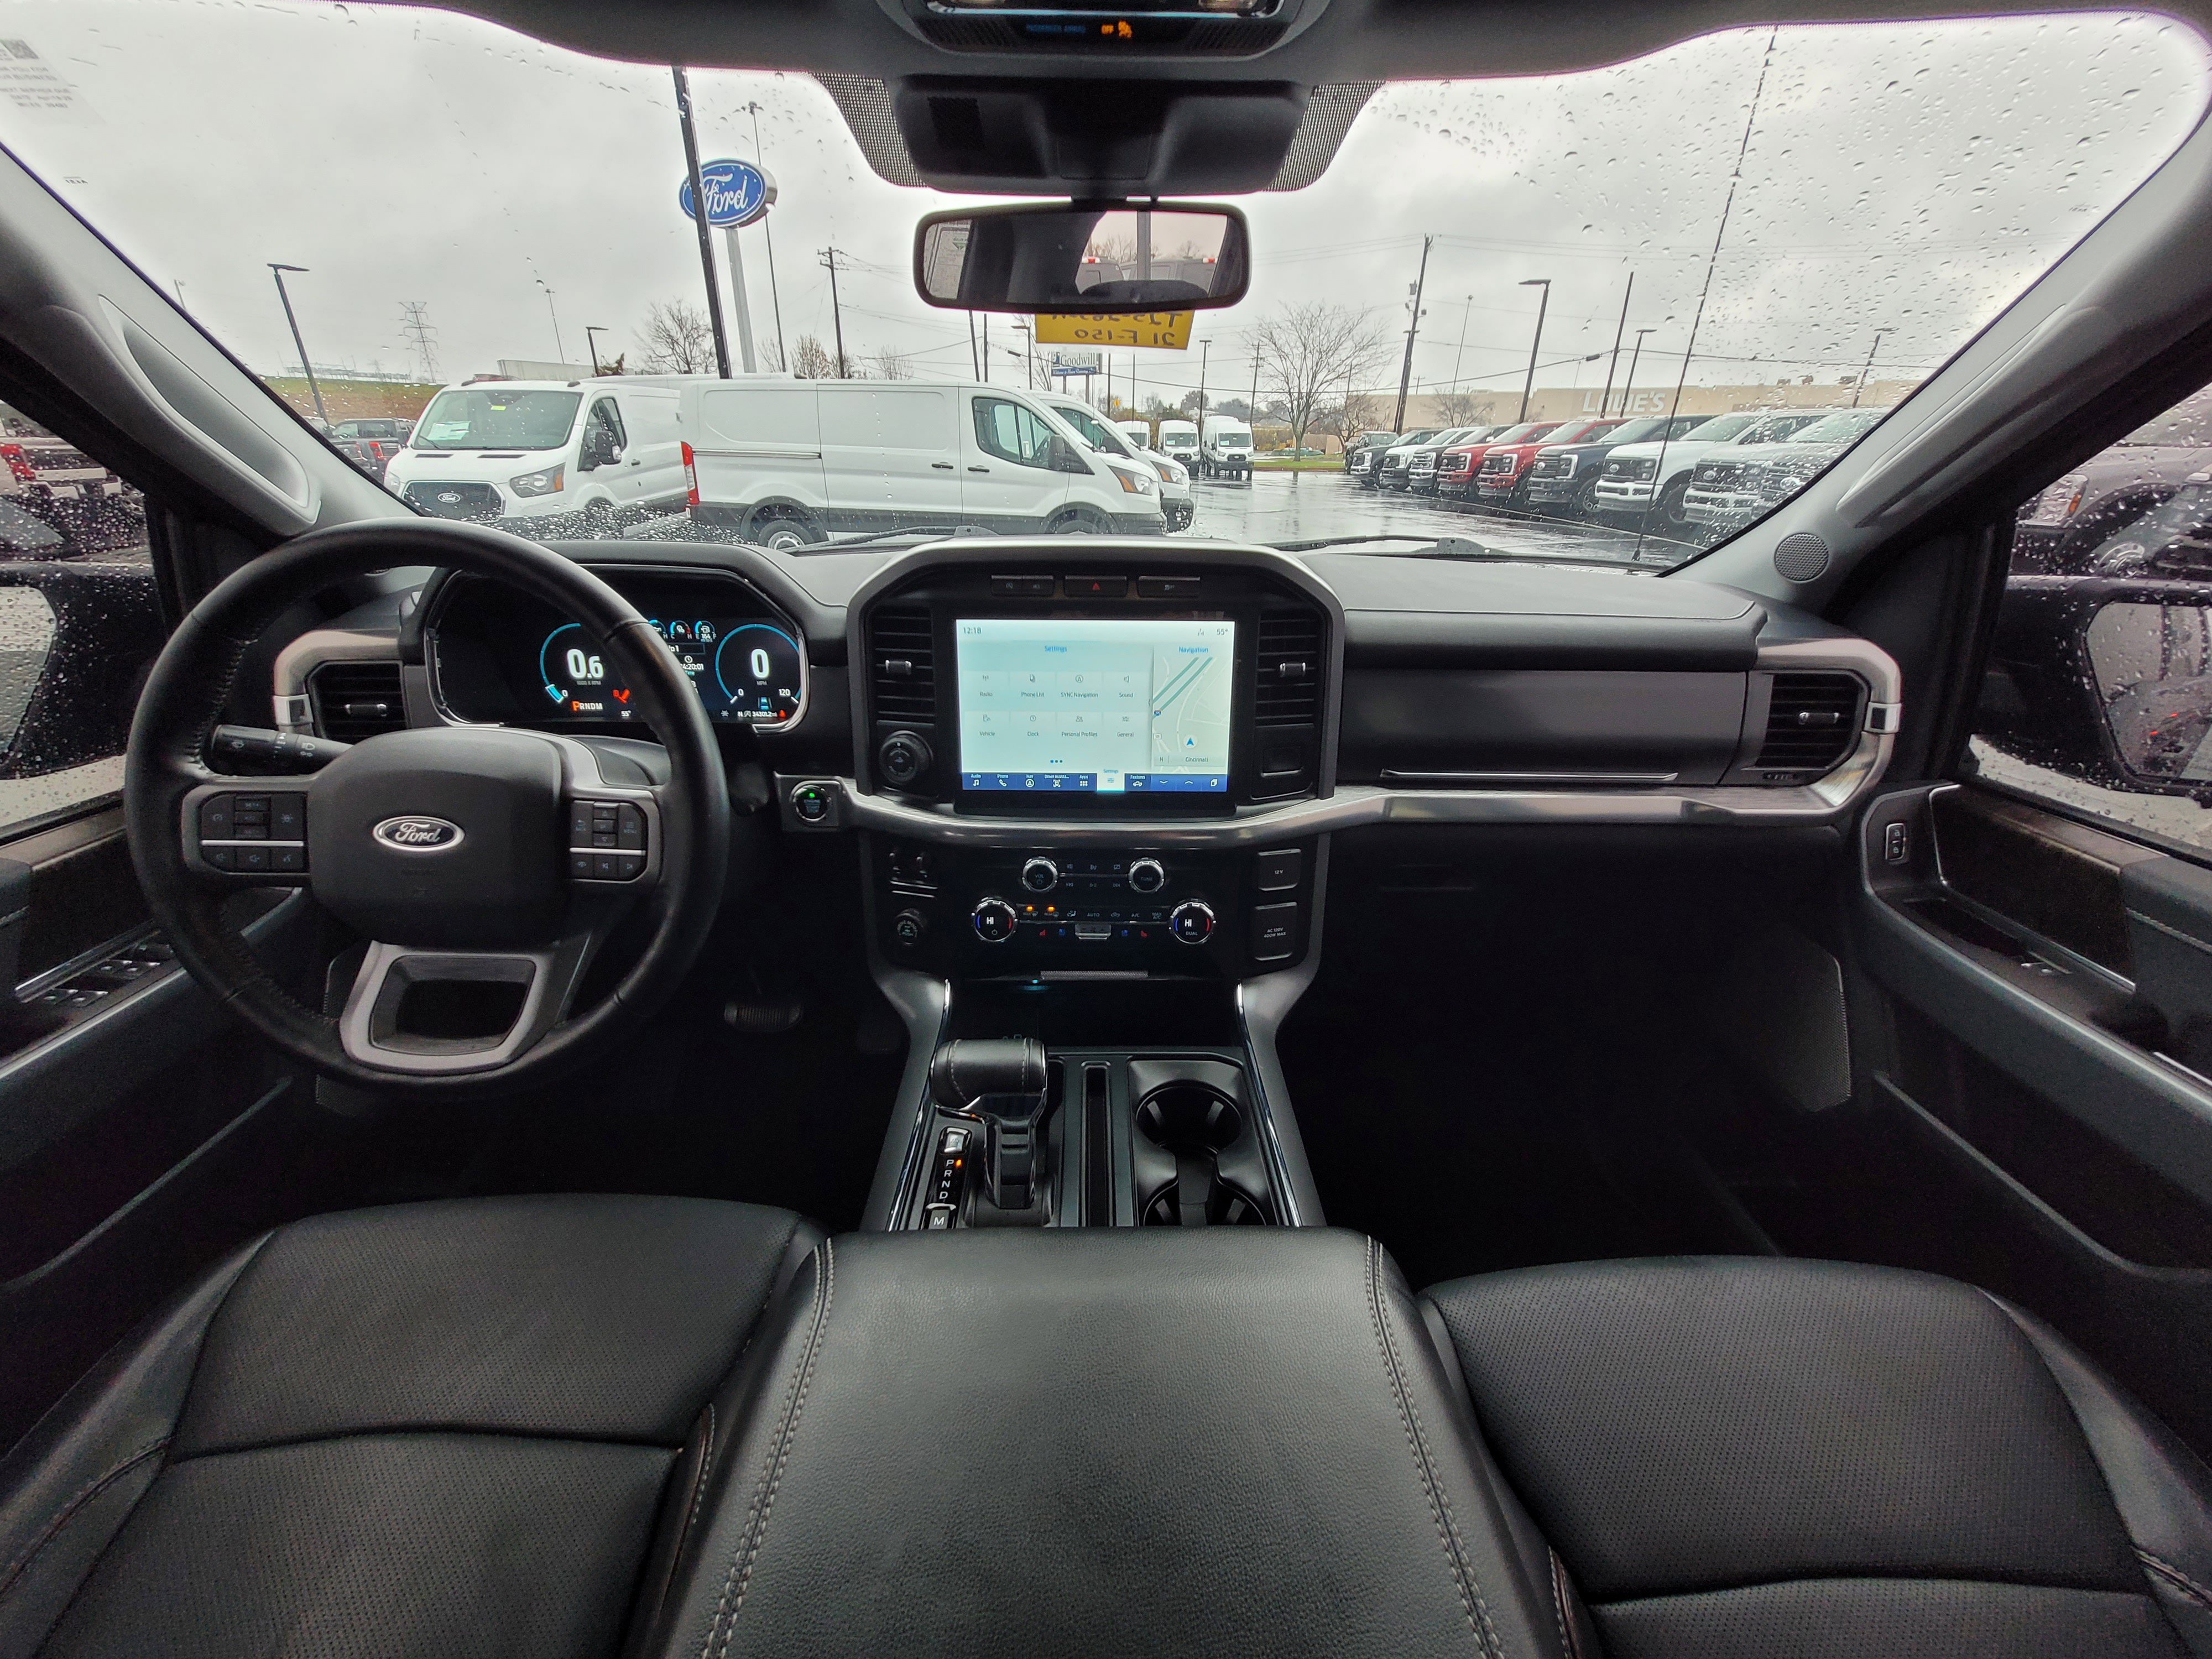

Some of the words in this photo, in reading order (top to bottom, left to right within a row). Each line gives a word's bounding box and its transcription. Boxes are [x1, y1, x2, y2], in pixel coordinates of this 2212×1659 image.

[1101, 25, 1114, 34] OFF
[702, 173, 748, 212] Ford
[1061, 352, 1095, 366] Goodwill
[1583, 391, 1665, 412] LOWE'S
[567, 649, 603, 679] 0.6
[752, 649, 769, 678] 0
[394, 822, 441, 843] Ford
[941, 1180, 951, 1188] N
[933, 1217, 945, 1225] M
